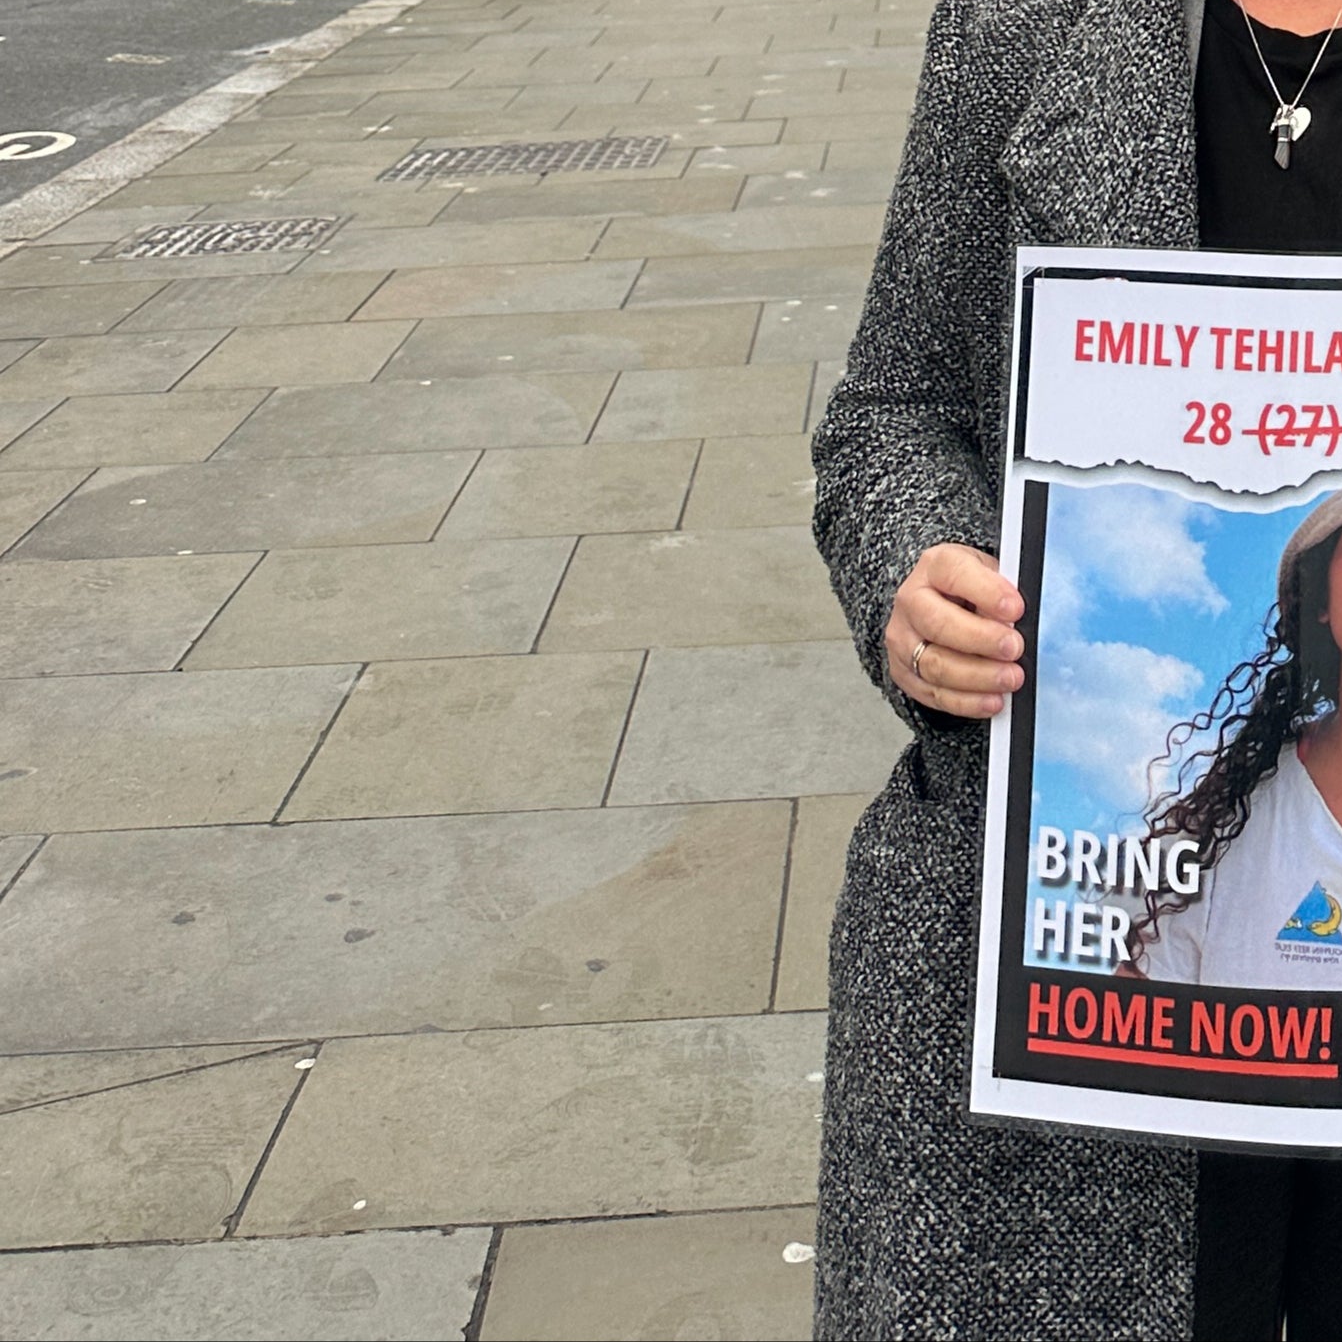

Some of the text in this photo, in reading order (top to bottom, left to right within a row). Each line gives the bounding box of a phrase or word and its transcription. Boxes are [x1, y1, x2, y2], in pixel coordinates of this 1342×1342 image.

[1074, 319, 1200, 368] EMILY
[1182, 401, 1233, 446] 28
[1035, 825, 1200, 894] BRING
[1031, 897, 1132, 962] HER
[1027, 982, 1333, 1061] HOME NOW!
